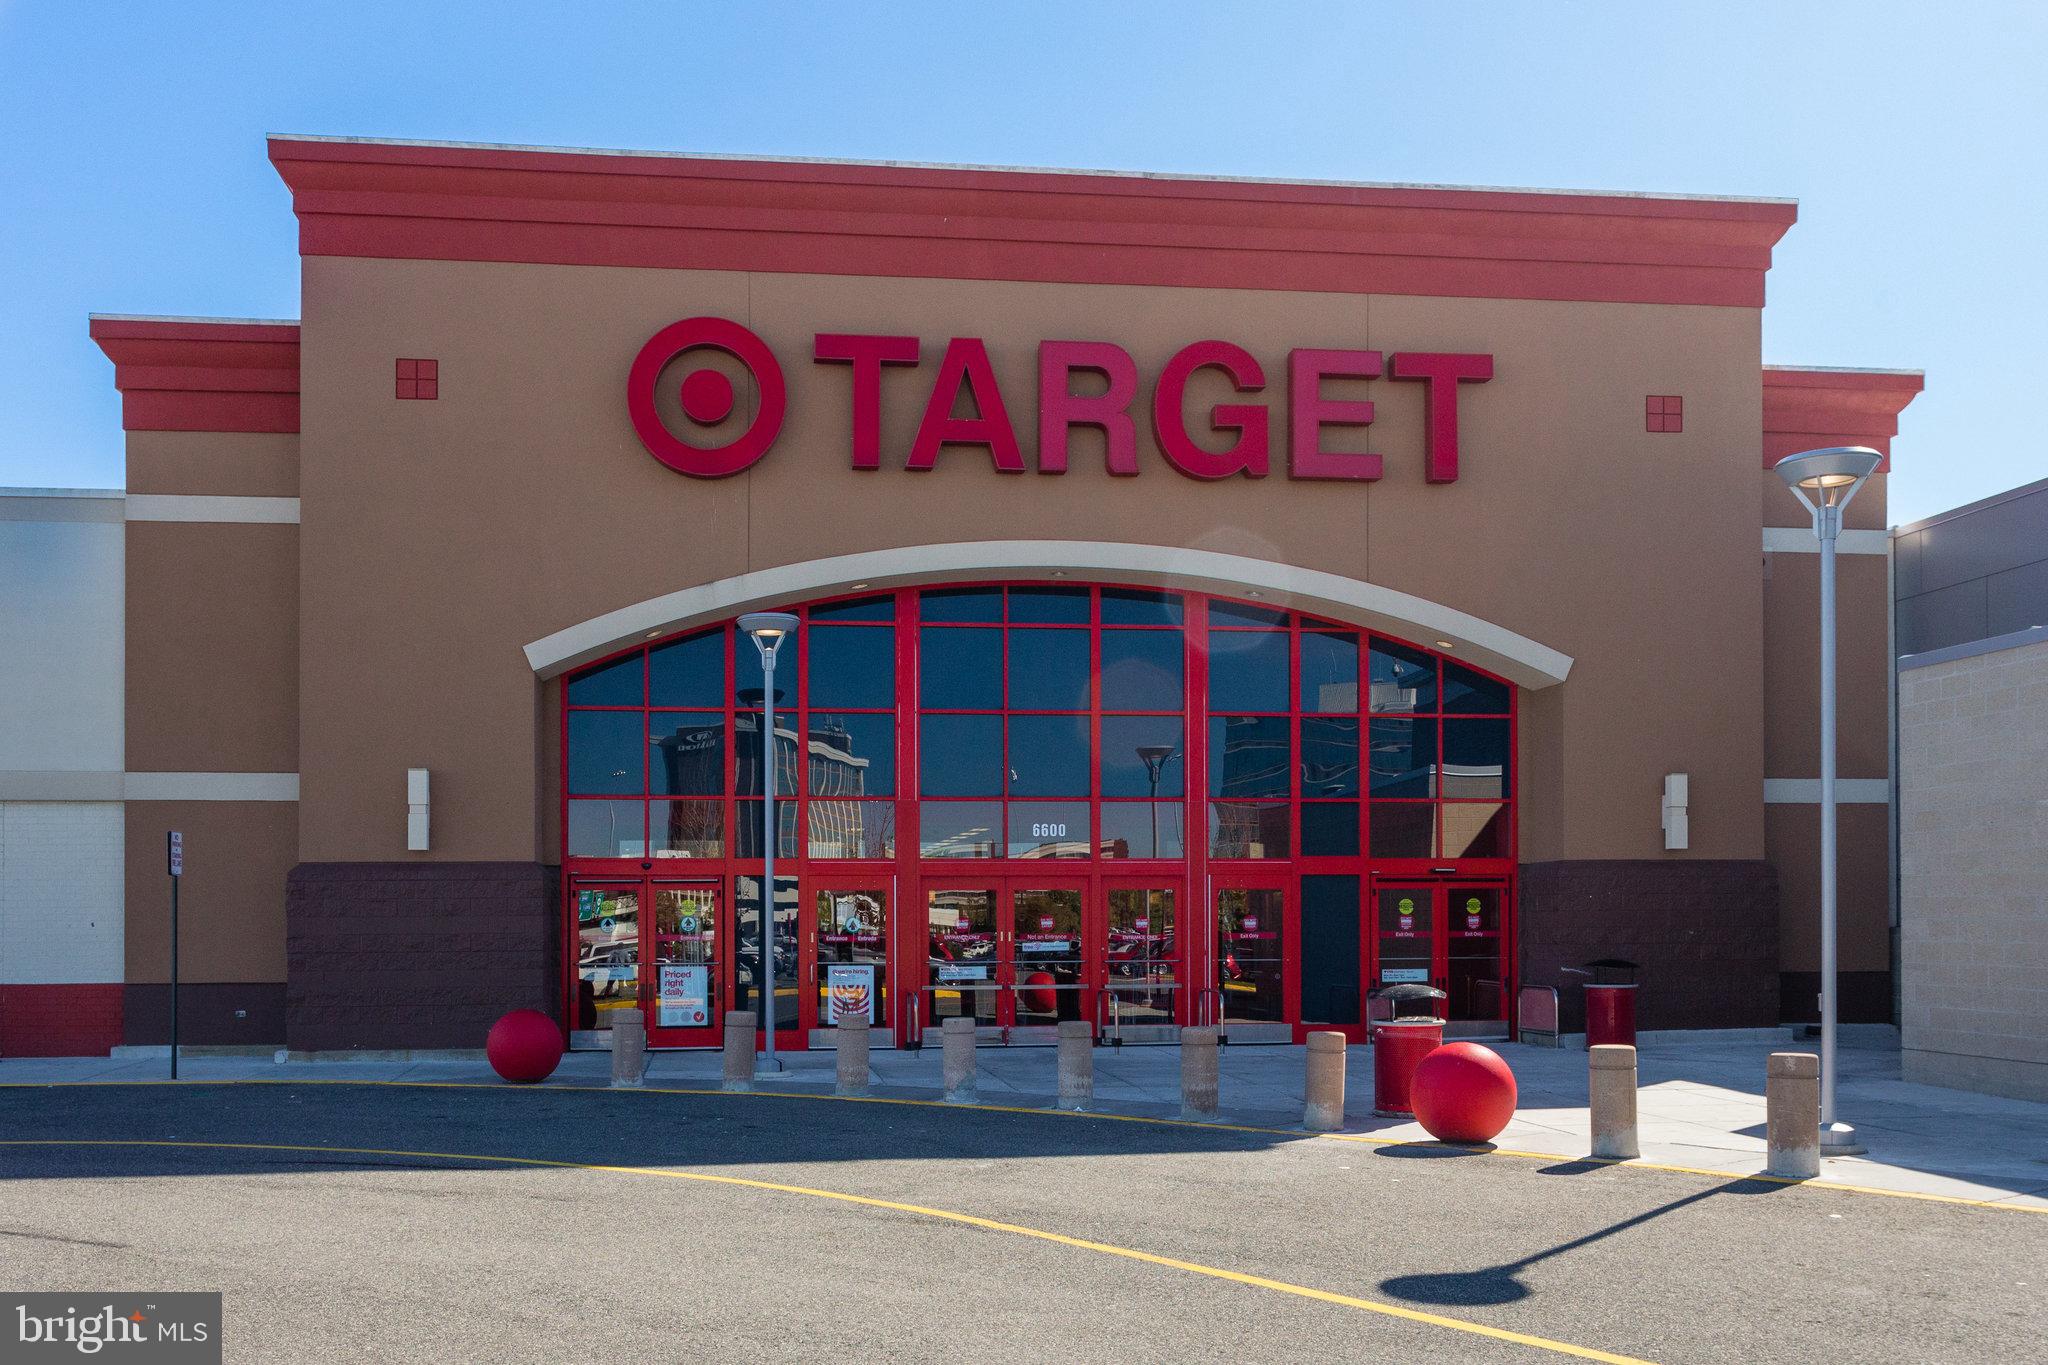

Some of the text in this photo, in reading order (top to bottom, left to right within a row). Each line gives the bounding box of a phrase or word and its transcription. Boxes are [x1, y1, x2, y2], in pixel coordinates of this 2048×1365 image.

[814, 333, 1494, 484] TARGET
[1032, 823, 1066, 837] 6600
[664, 970, 692, 978] Priced
[664, 979, 684, 988] right
[664, 988, 685, 998] daily
